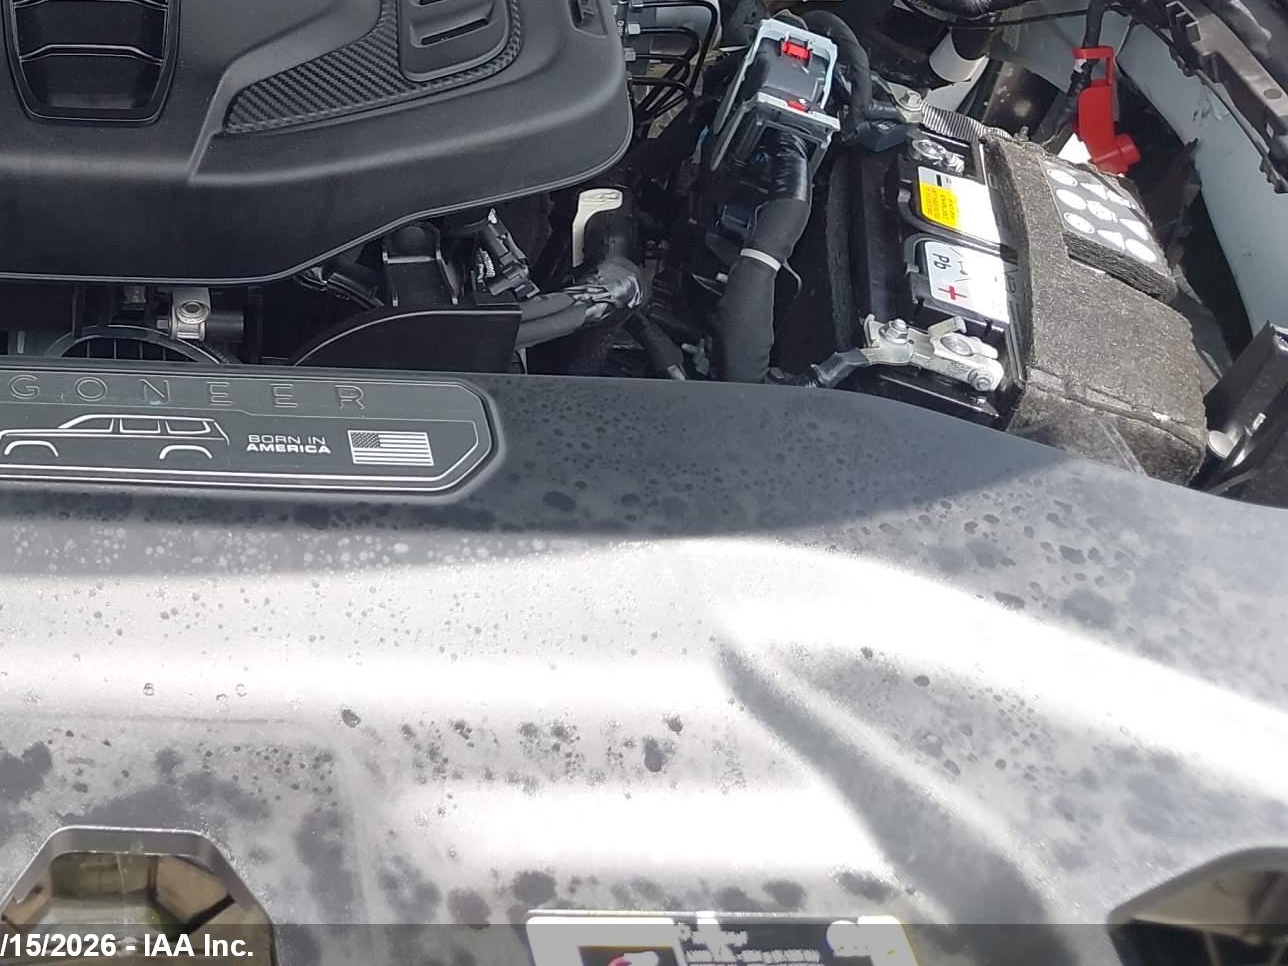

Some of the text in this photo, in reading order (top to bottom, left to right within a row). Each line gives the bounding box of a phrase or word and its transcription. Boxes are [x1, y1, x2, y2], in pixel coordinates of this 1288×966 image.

[932, 252, 952, 270] Pb
[248, 434, 326, 444] BORN IN
[246, 443, 331, 454] AMERICA
